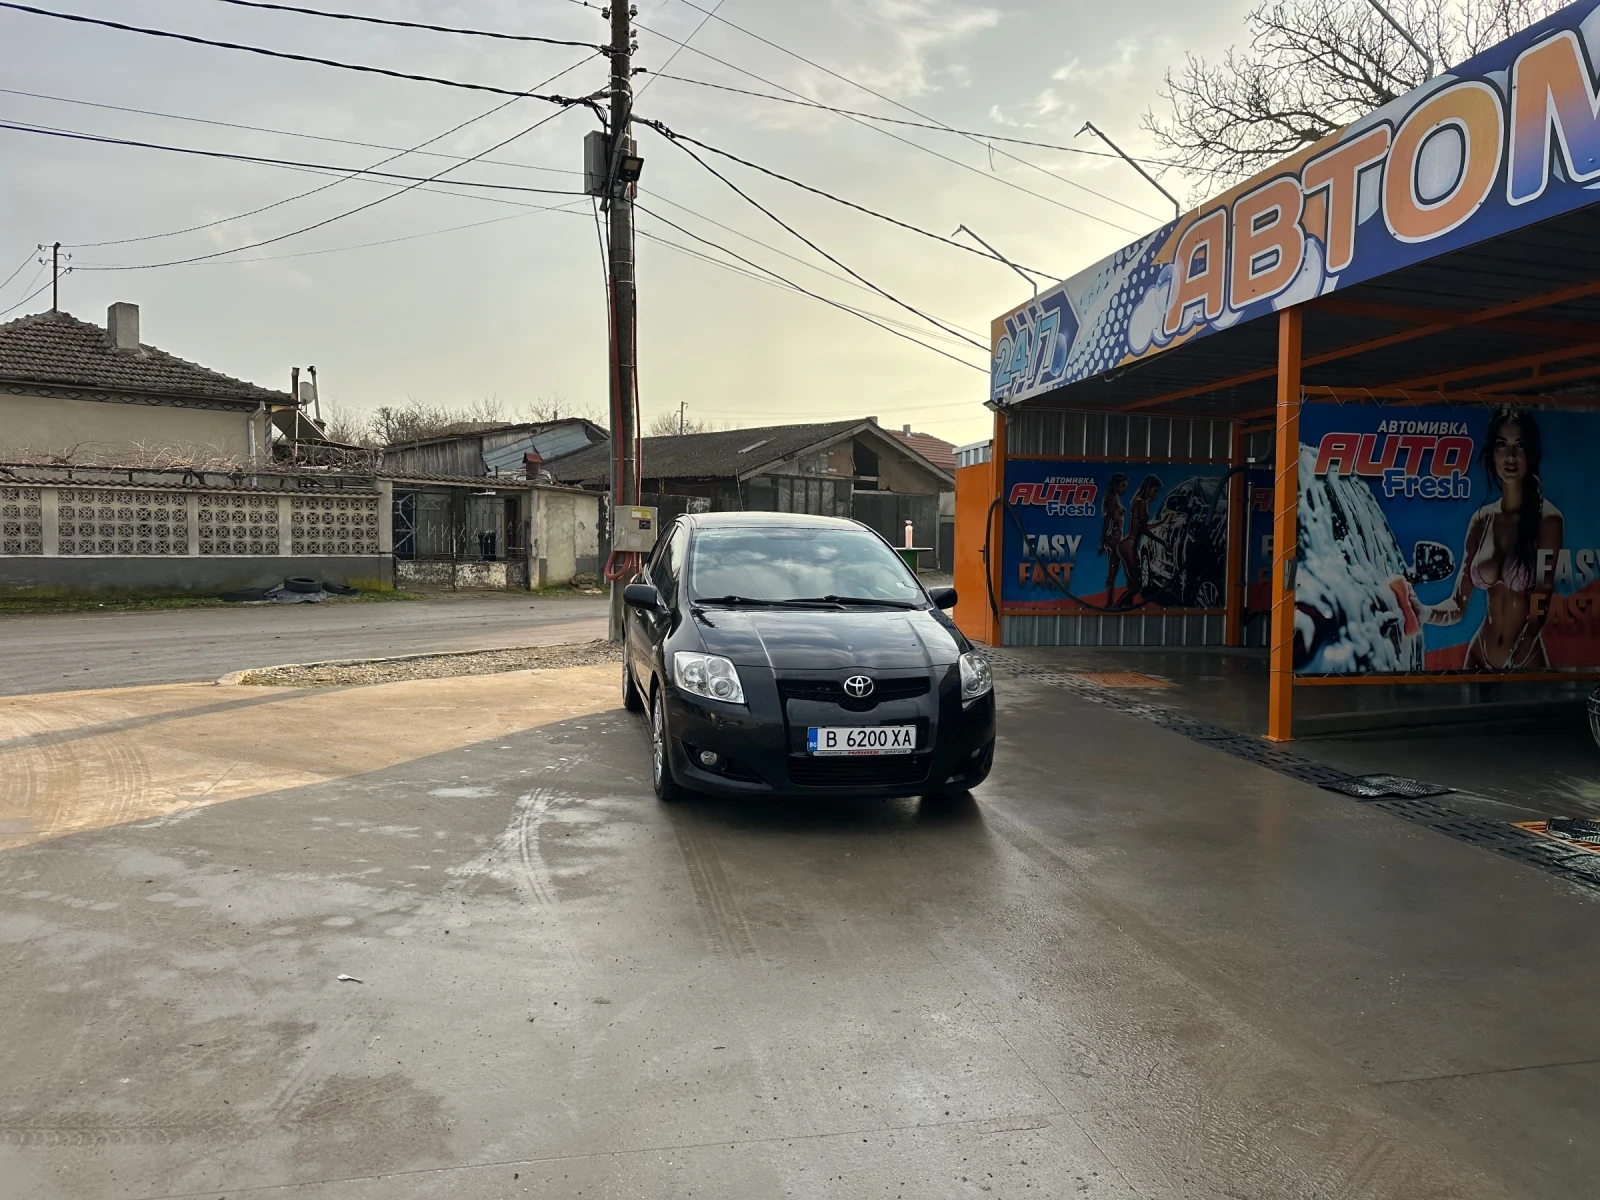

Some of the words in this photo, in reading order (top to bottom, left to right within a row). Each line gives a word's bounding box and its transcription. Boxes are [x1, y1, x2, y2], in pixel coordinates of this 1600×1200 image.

[995, 306, 1061, 390] 24/7
[1378, 420, 1468, 435] АВТОМИВКА
[1314, 432, 1474, 477] AUTO
[1009, 482, 1098, 505] AUTO
[1044, 476, 1095, 485] АВТОМИВКА
[1382, 468, 1471, 498] Fresh
[1046, 500, 1096, 516] Fresh
[1022, 534, 1082, 560] EASY
[1018, 563, 1074, 589] FAST
[1536, 548, 1600, 590] EAS
[826, 730, 838, 748] B
[846, 730, 888, 748] 6200
[891, 729, 912, 747] XA
